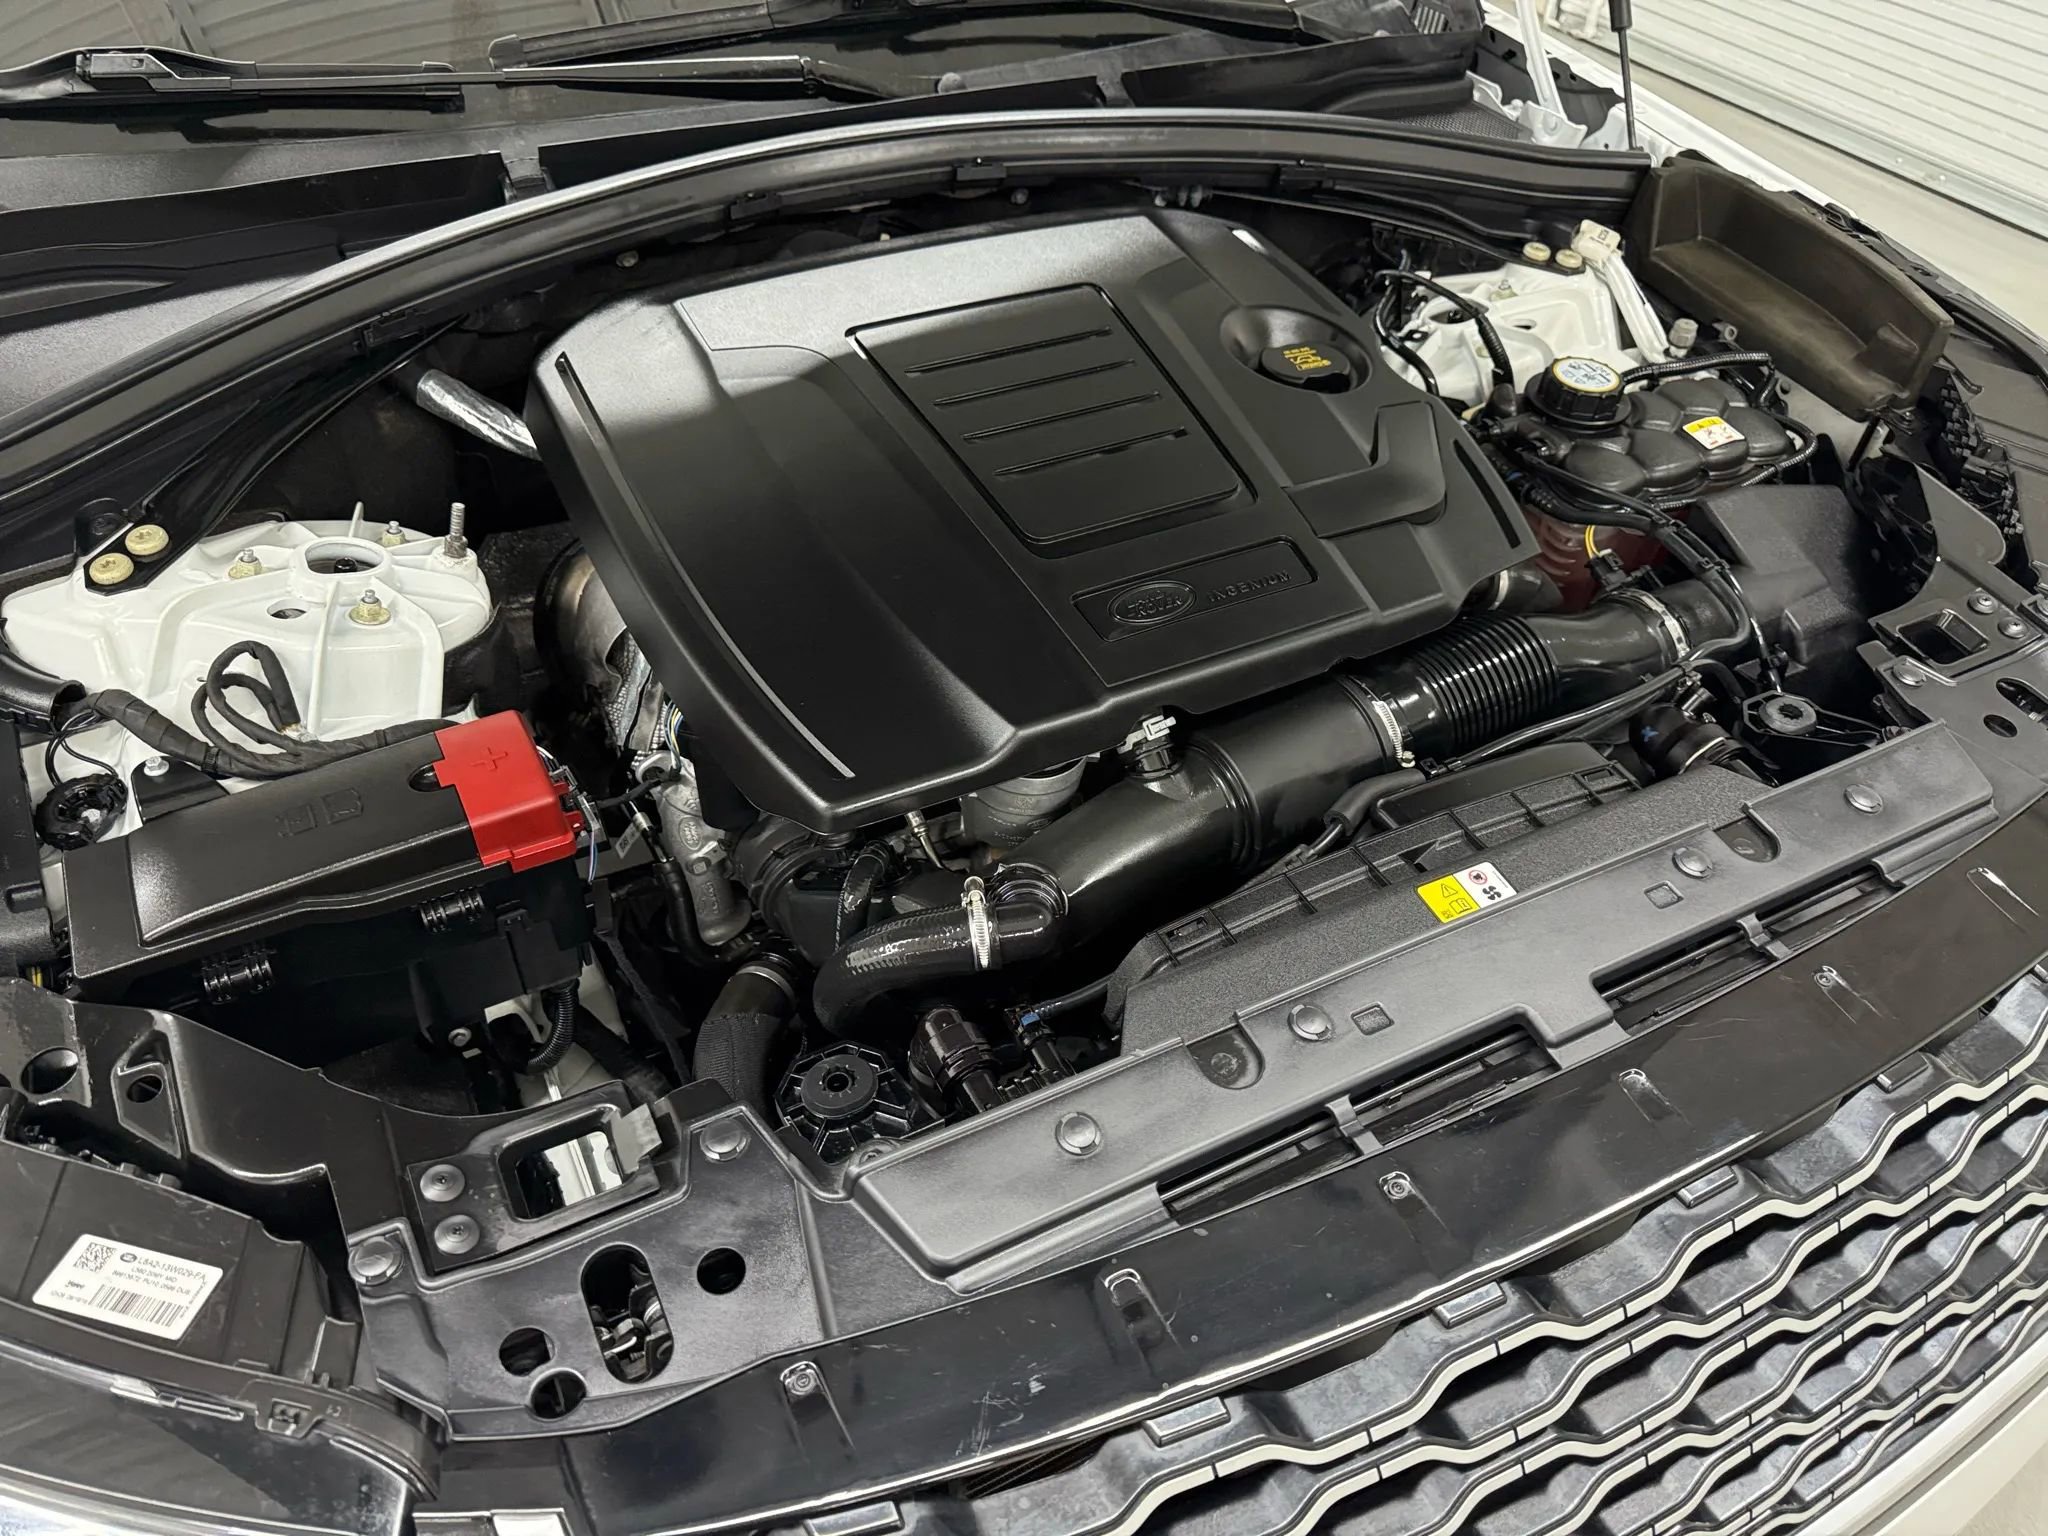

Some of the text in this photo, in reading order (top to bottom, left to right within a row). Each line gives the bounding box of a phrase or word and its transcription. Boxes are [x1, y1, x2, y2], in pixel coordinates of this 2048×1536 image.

[1207, 570, 1292, 602] INGENIUM
[1128, 590, 1166, 608] LAND
[1136, 595, 1183, 618] ROVER
